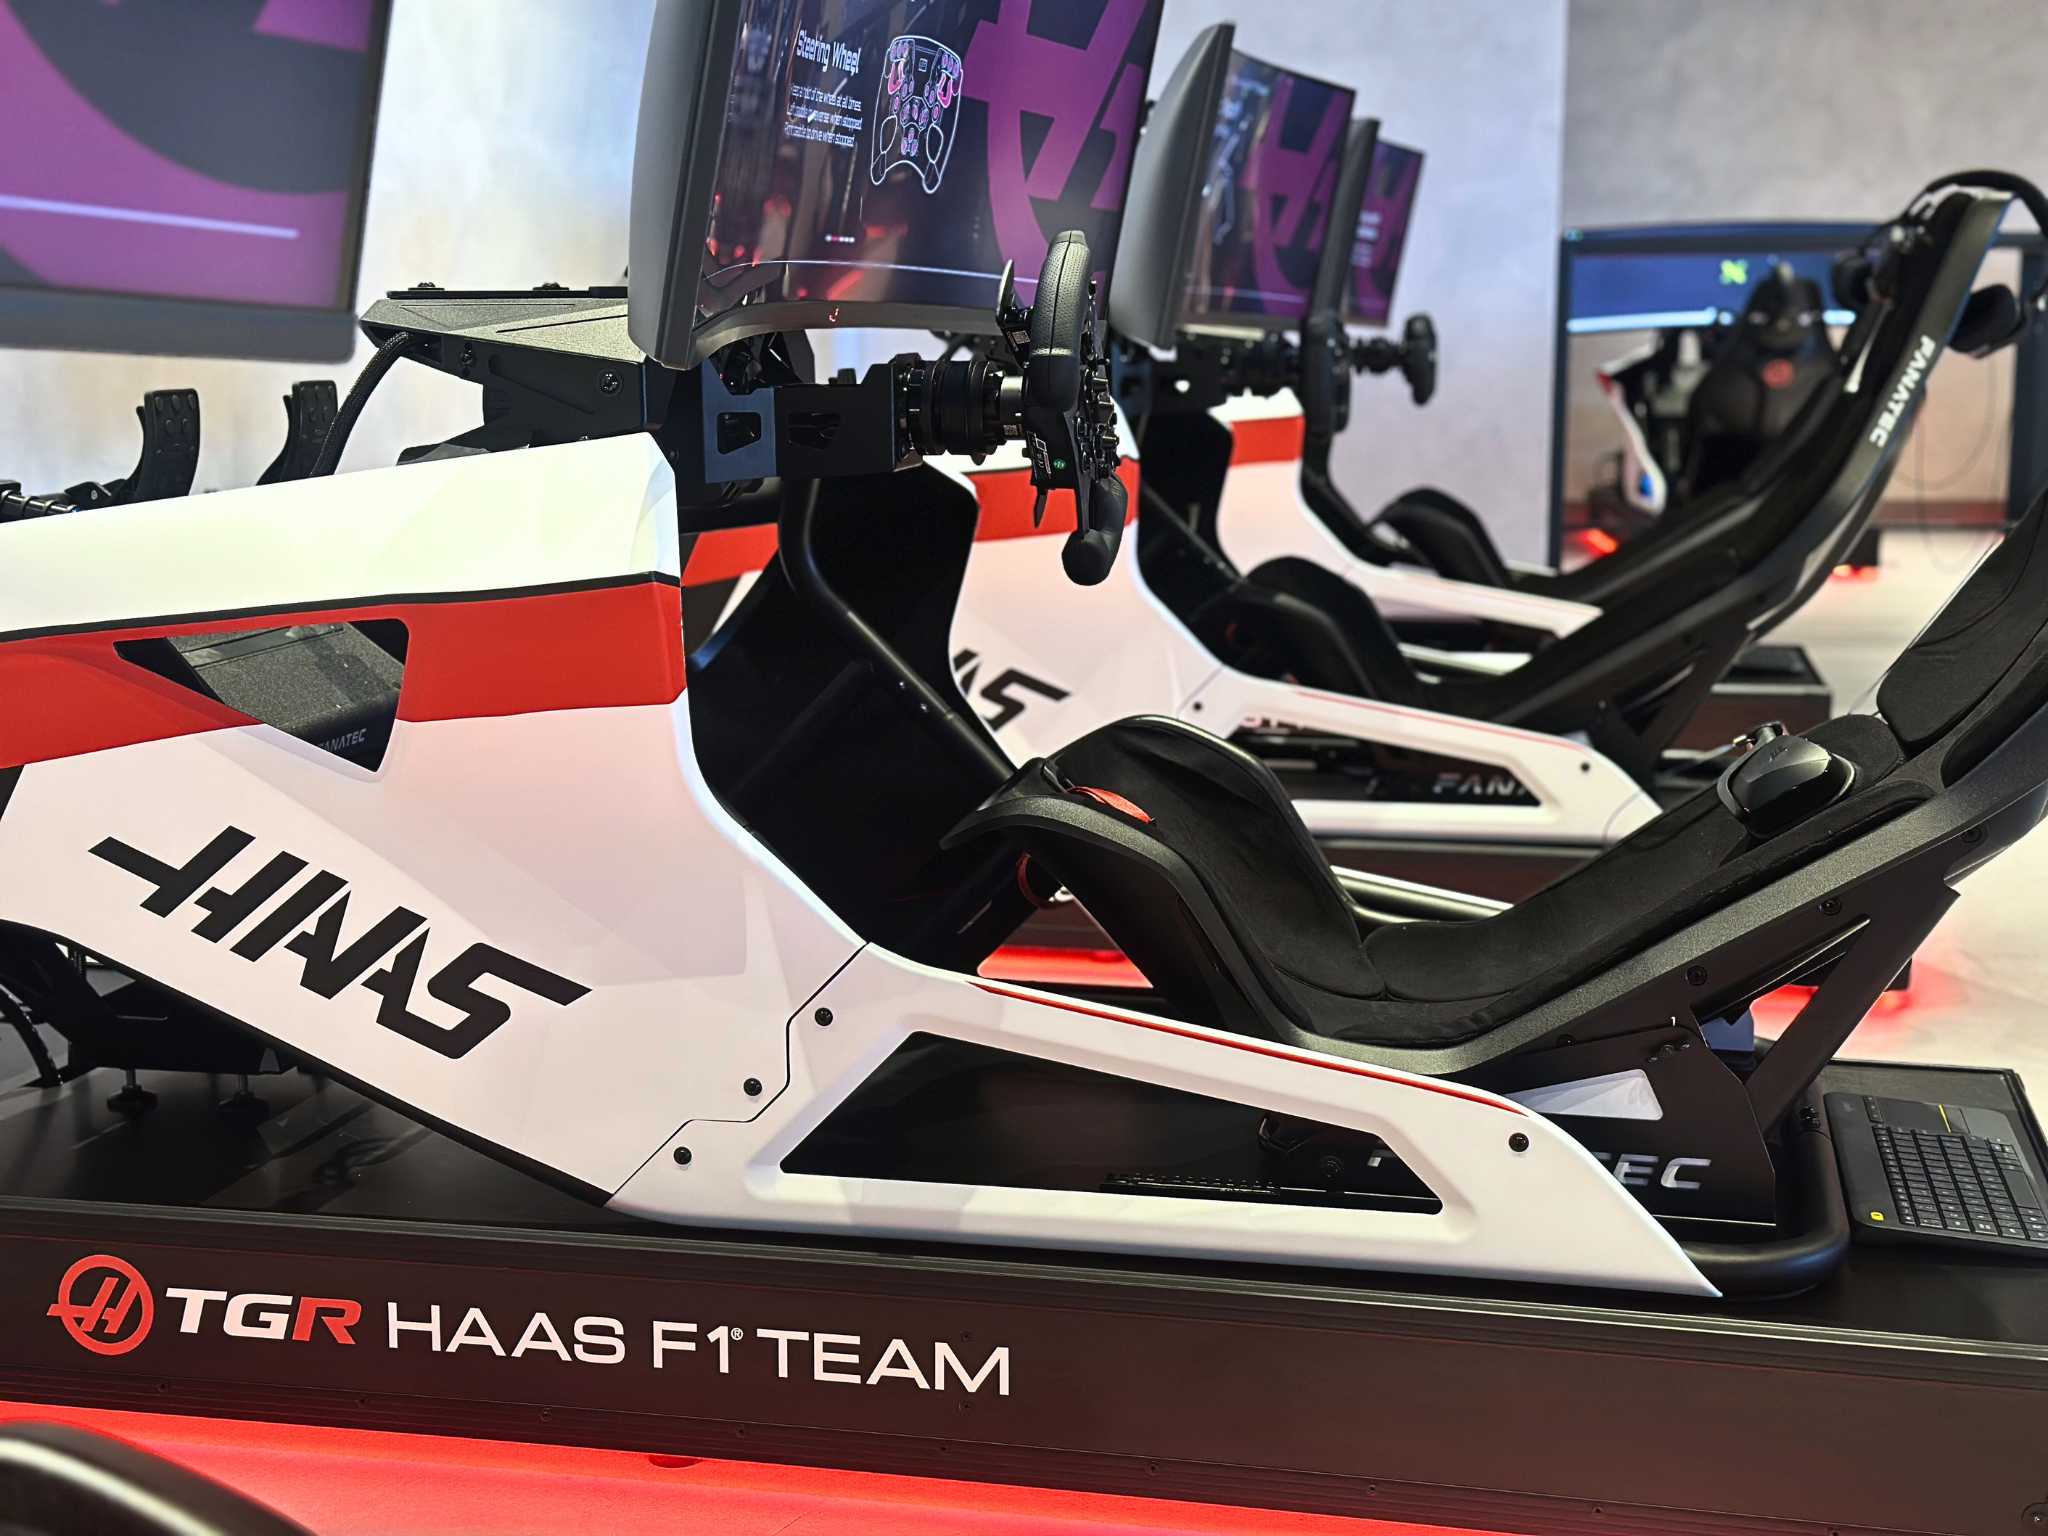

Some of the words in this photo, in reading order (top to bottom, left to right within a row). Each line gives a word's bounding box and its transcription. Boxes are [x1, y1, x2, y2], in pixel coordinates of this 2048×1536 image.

[796, 29, 831, 73] Steering
[832, 41, 861, 75] Wheel
[1869, 334, 1936, 448] FANATEC
[88, 825, 593, 1060] HAAS
[1594, 1151, 1711, 1190] EC
[165, 1287, 362, 1345] TGR
[387, 1301, 626, 1366] HAAS
[756, 1328, 1009, 1396] TEAM
